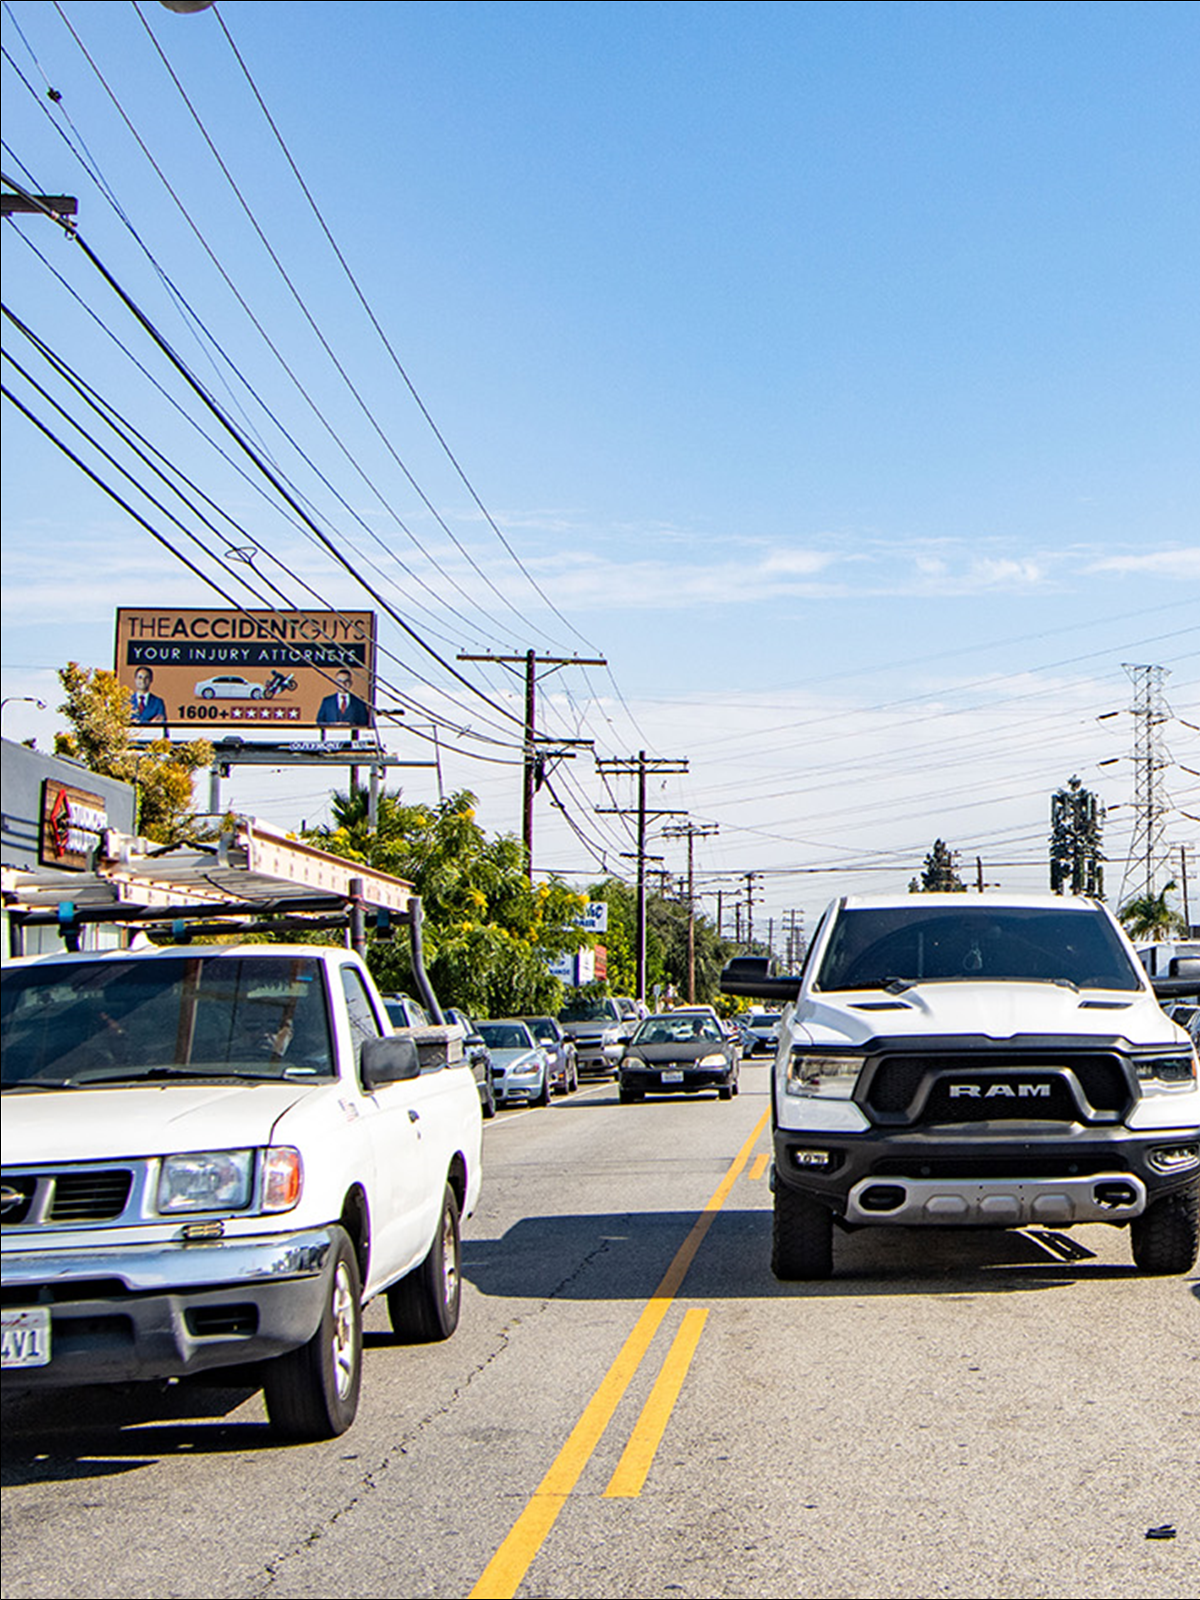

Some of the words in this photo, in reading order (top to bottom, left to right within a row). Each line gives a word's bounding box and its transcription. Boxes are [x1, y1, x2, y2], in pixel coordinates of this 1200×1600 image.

[133, 647, 181, 660] YOUR
[189, 648, 251, 661] INJURY
[258, 648, 357, 662] ATTORNEYS
[178, 705, 230, 720] 1600+
[949, 1083, 1051, 1098] RAM
